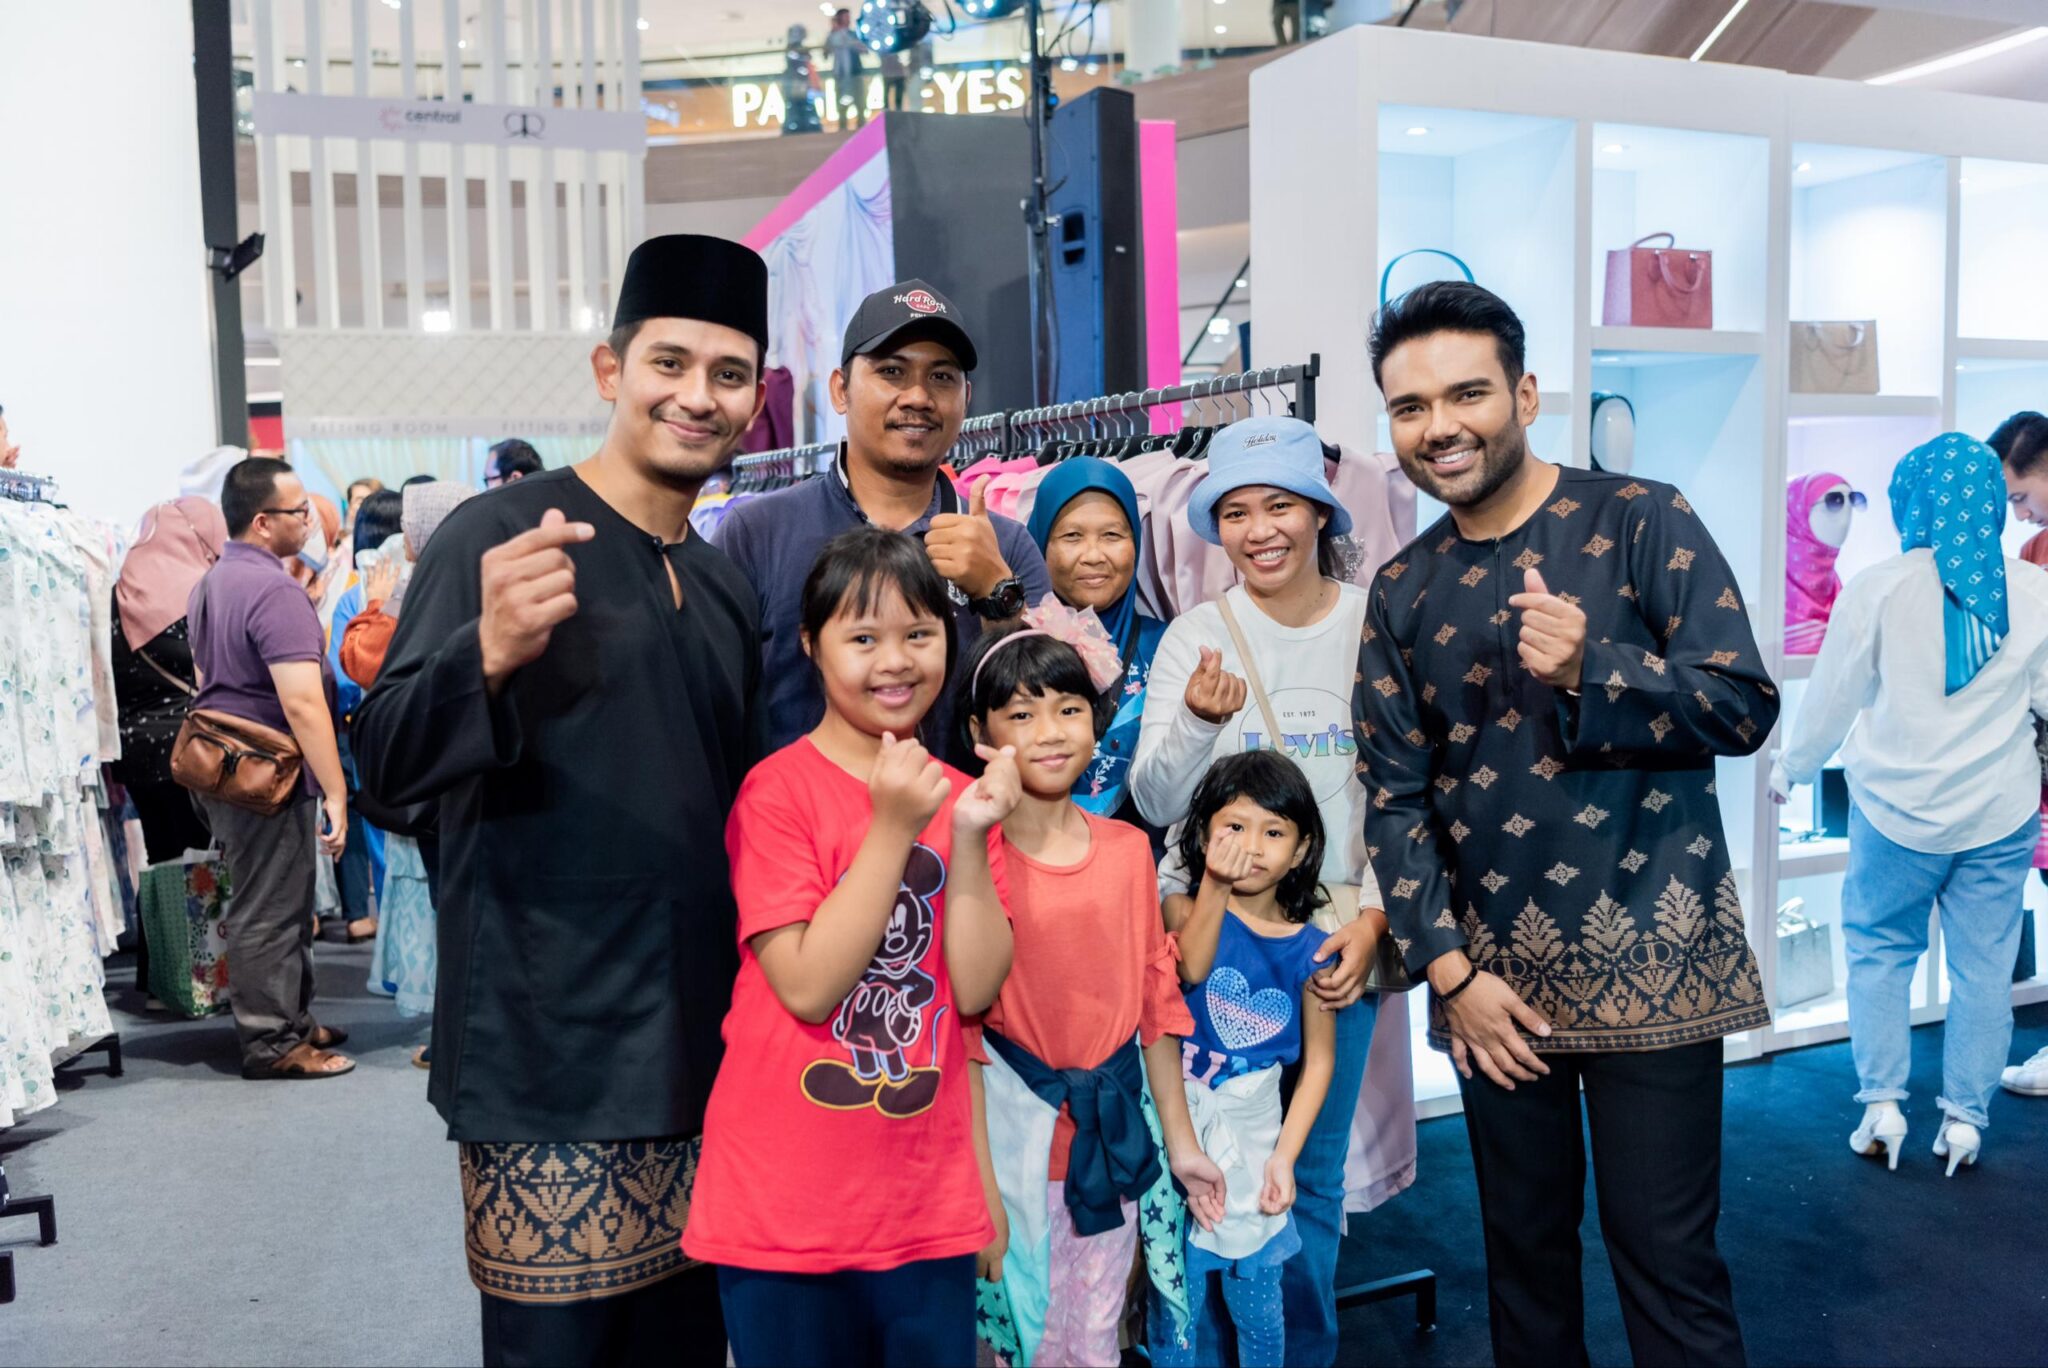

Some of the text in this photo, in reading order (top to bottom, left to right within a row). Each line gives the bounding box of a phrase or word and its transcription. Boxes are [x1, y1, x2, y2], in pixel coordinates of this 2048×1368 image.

[405, 110, 462, 124] central
[893, 294, 948, 314] Hard Rock
[392, 422, 449, 435] ROOM
[502, 420, 569, 433] FITTING
